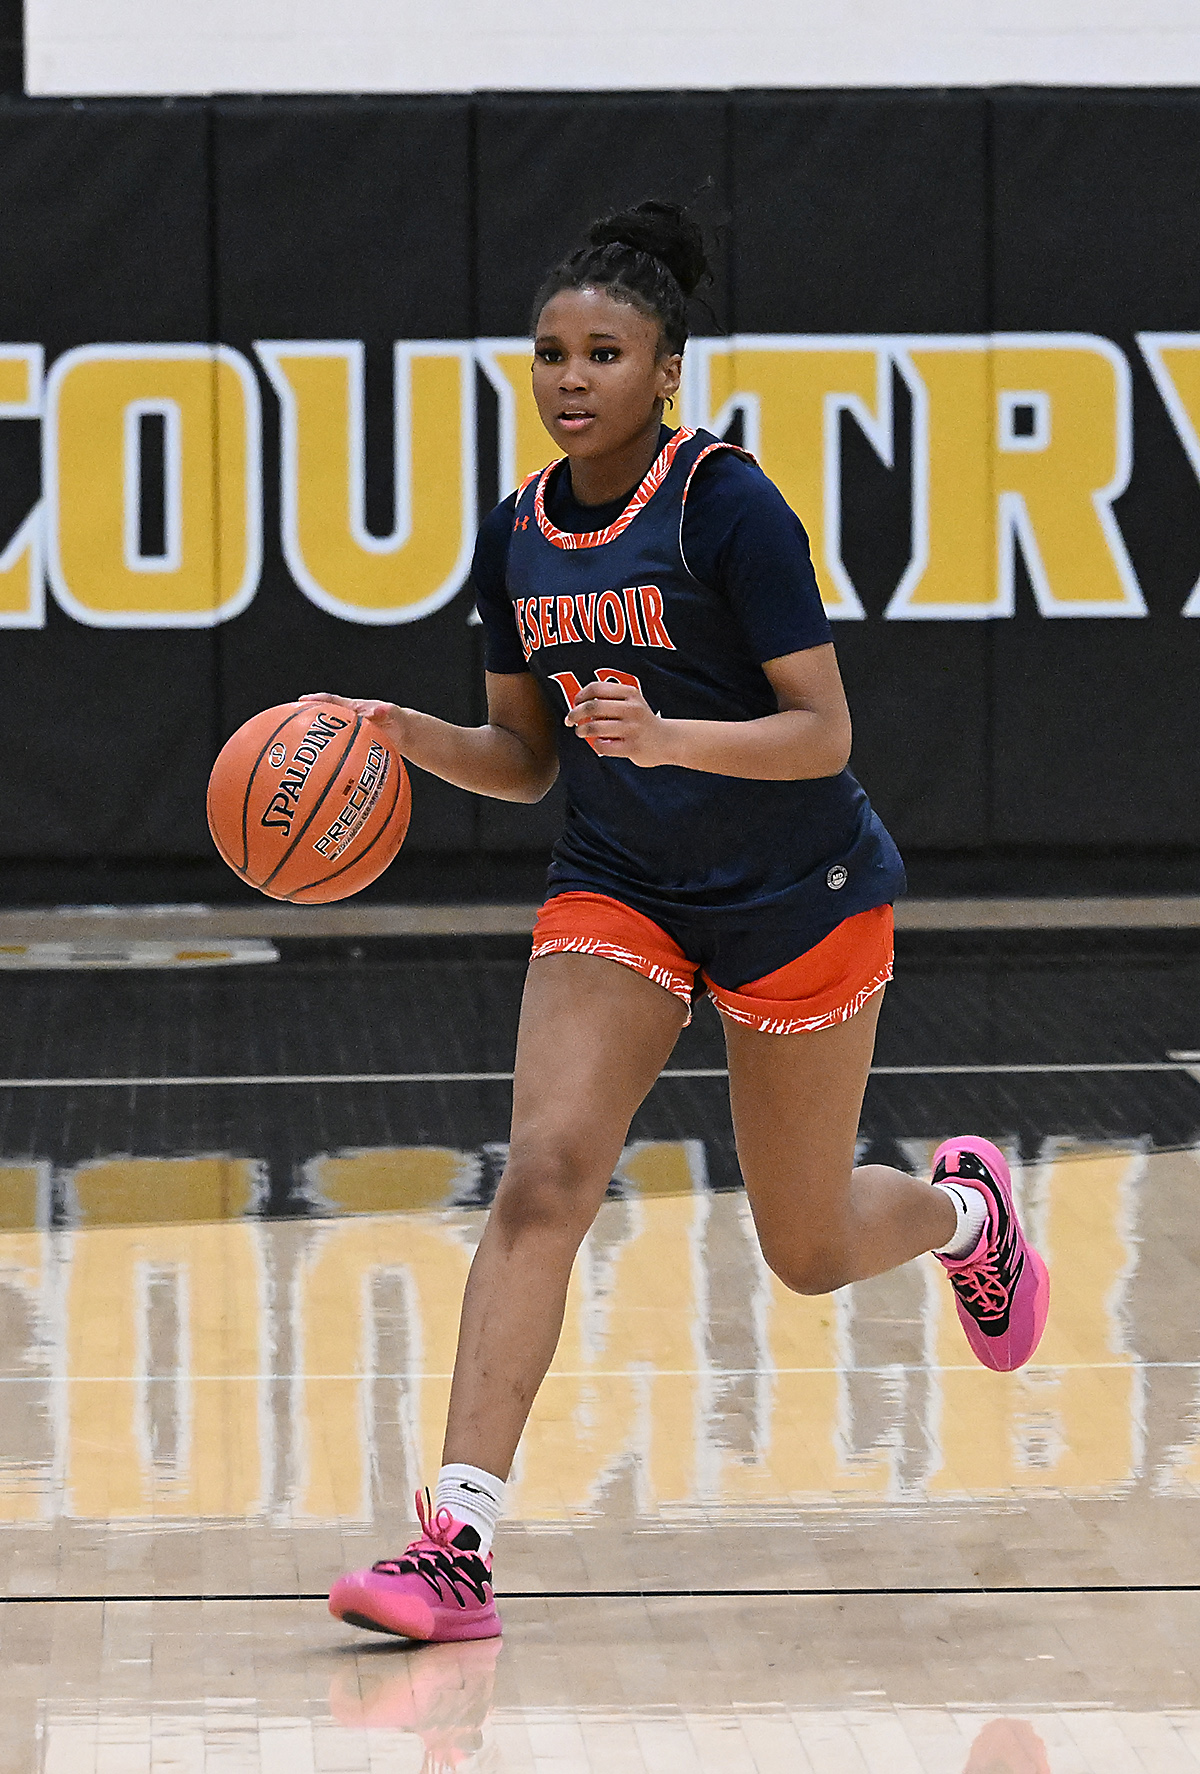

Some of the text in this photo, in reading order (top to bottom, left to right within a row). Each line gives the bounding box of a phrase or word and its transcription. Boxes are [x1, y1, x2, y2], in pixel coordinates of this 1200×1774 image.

[512, 584, 677, 662] ESERVOIR
[261, 711, 350, 837] SPALDING
[313, 739, 384, 857] PRECISION
